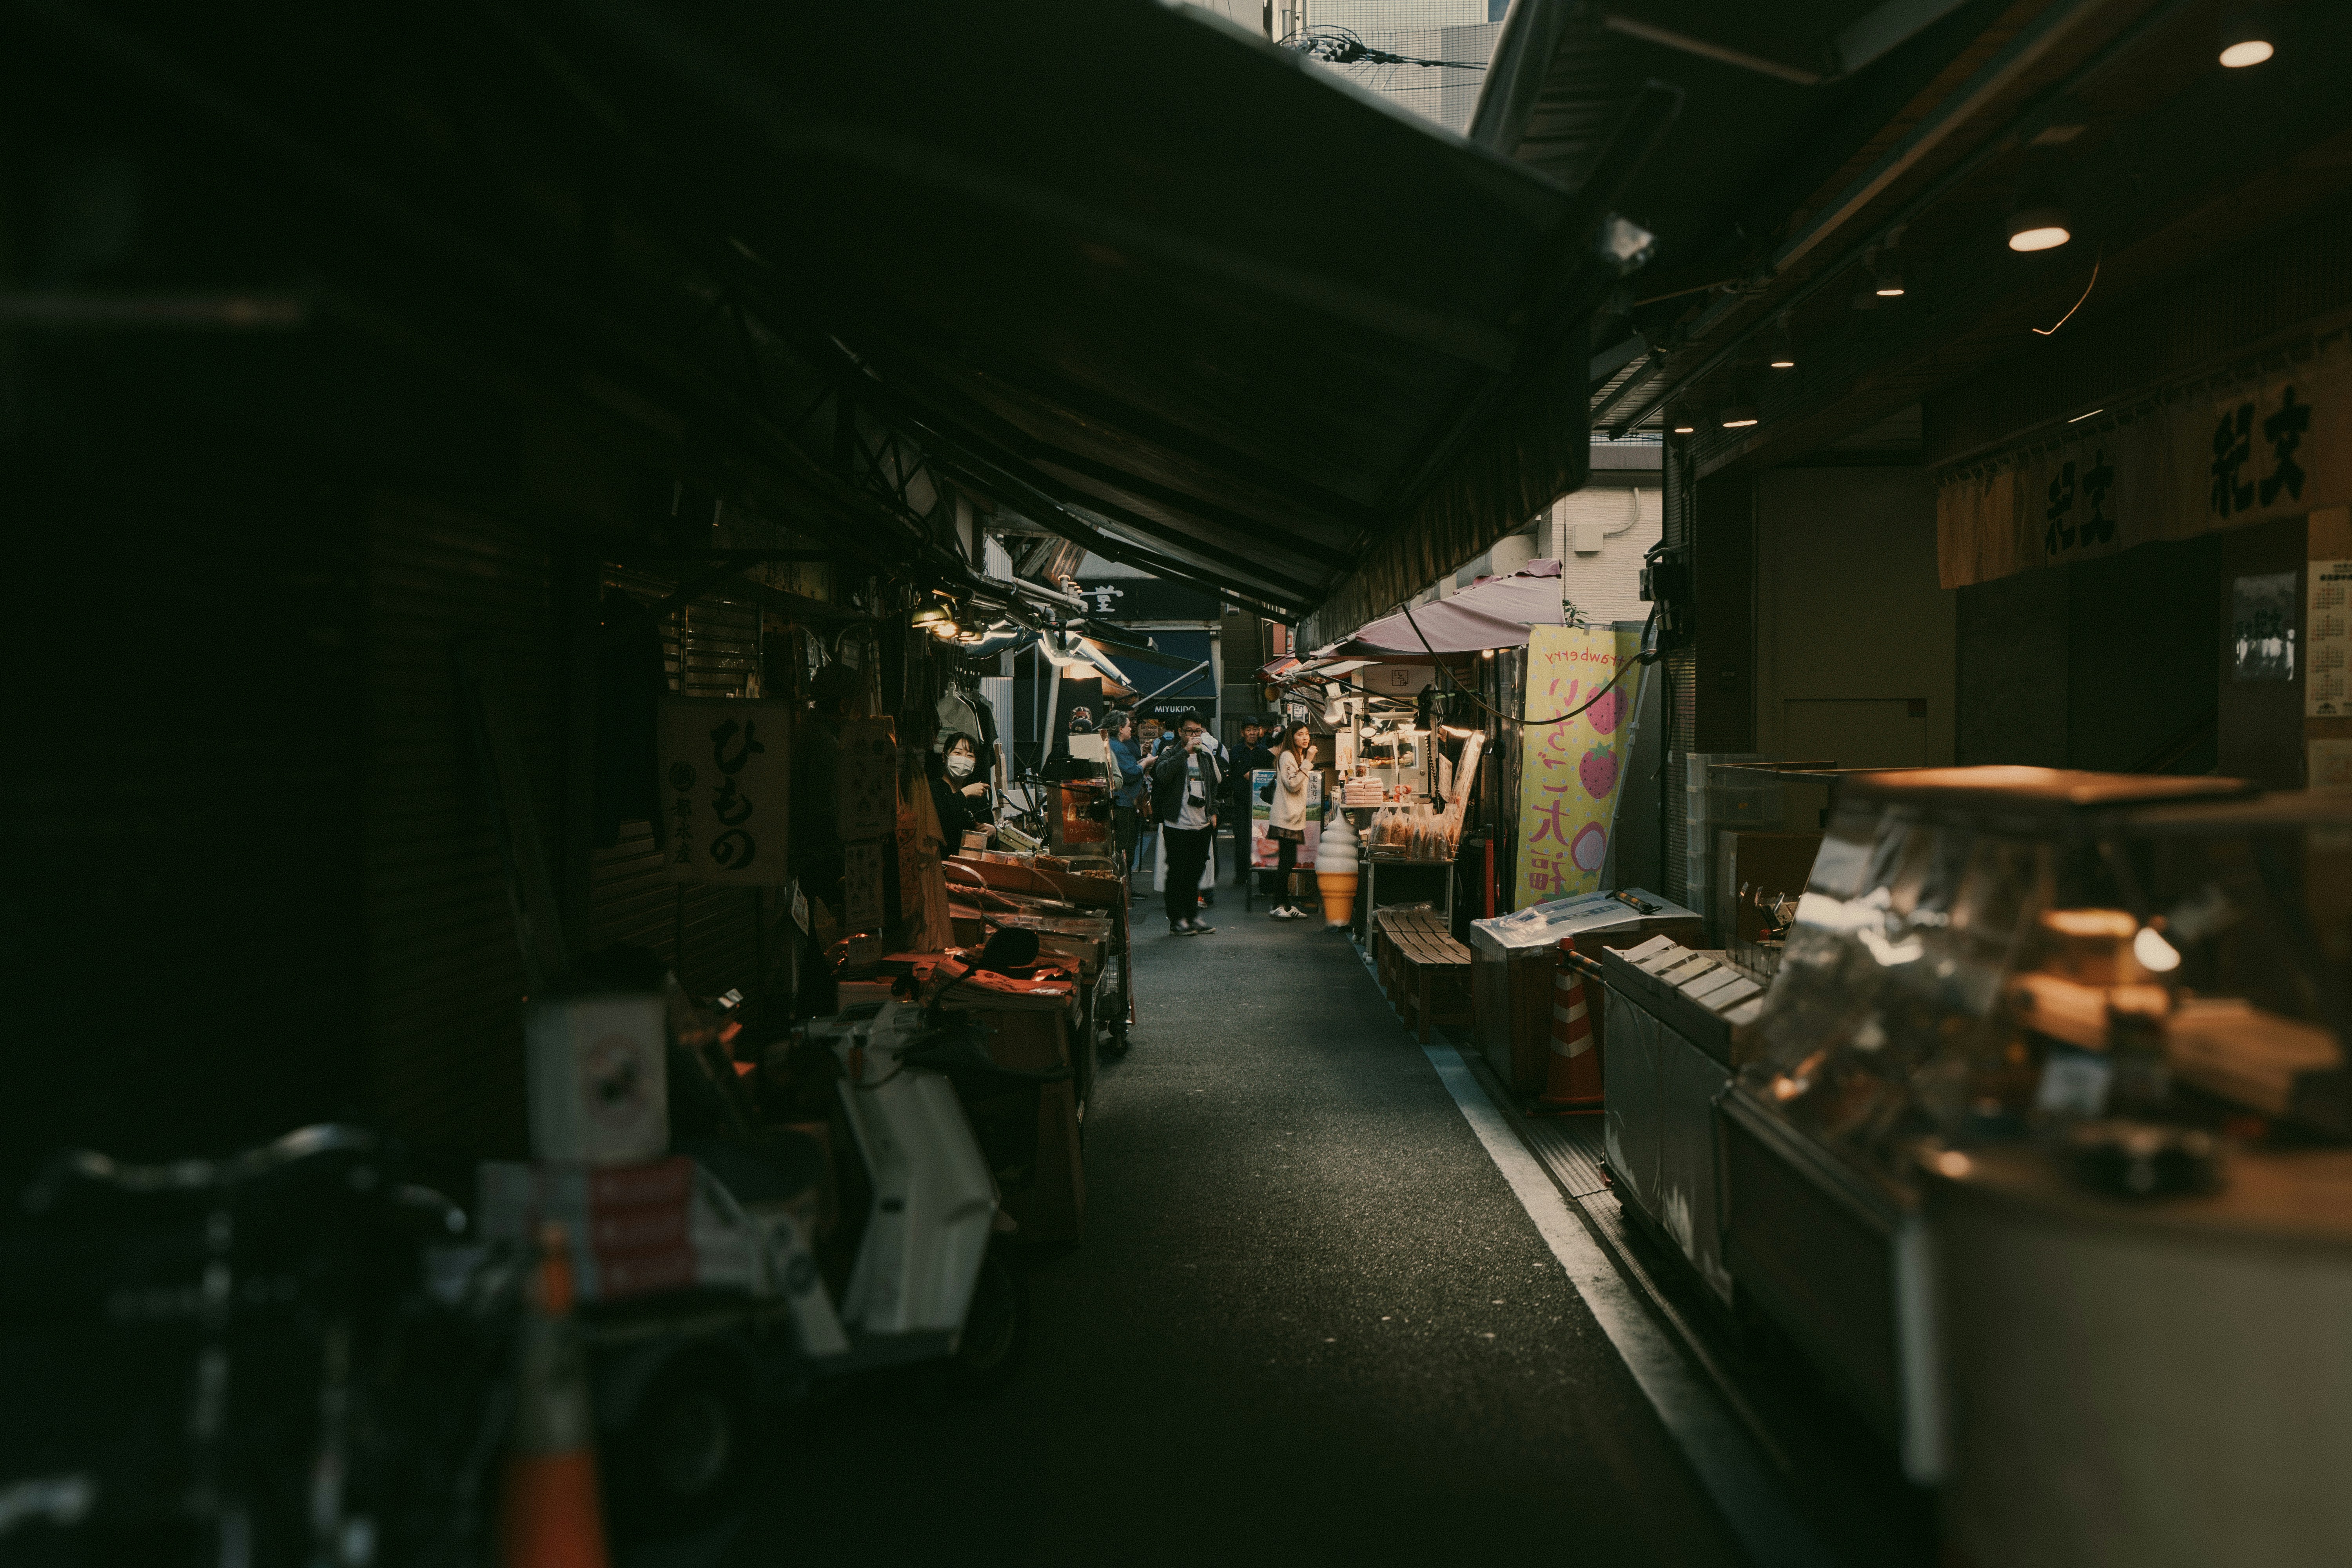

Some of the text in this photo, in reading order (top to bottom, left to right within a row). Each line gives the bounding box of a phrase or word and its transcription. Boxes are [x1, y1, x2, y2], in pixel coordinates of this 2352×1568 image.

[1080, 585, 1124, 612] 堂
[710, 719, 764, 871] ひもの
